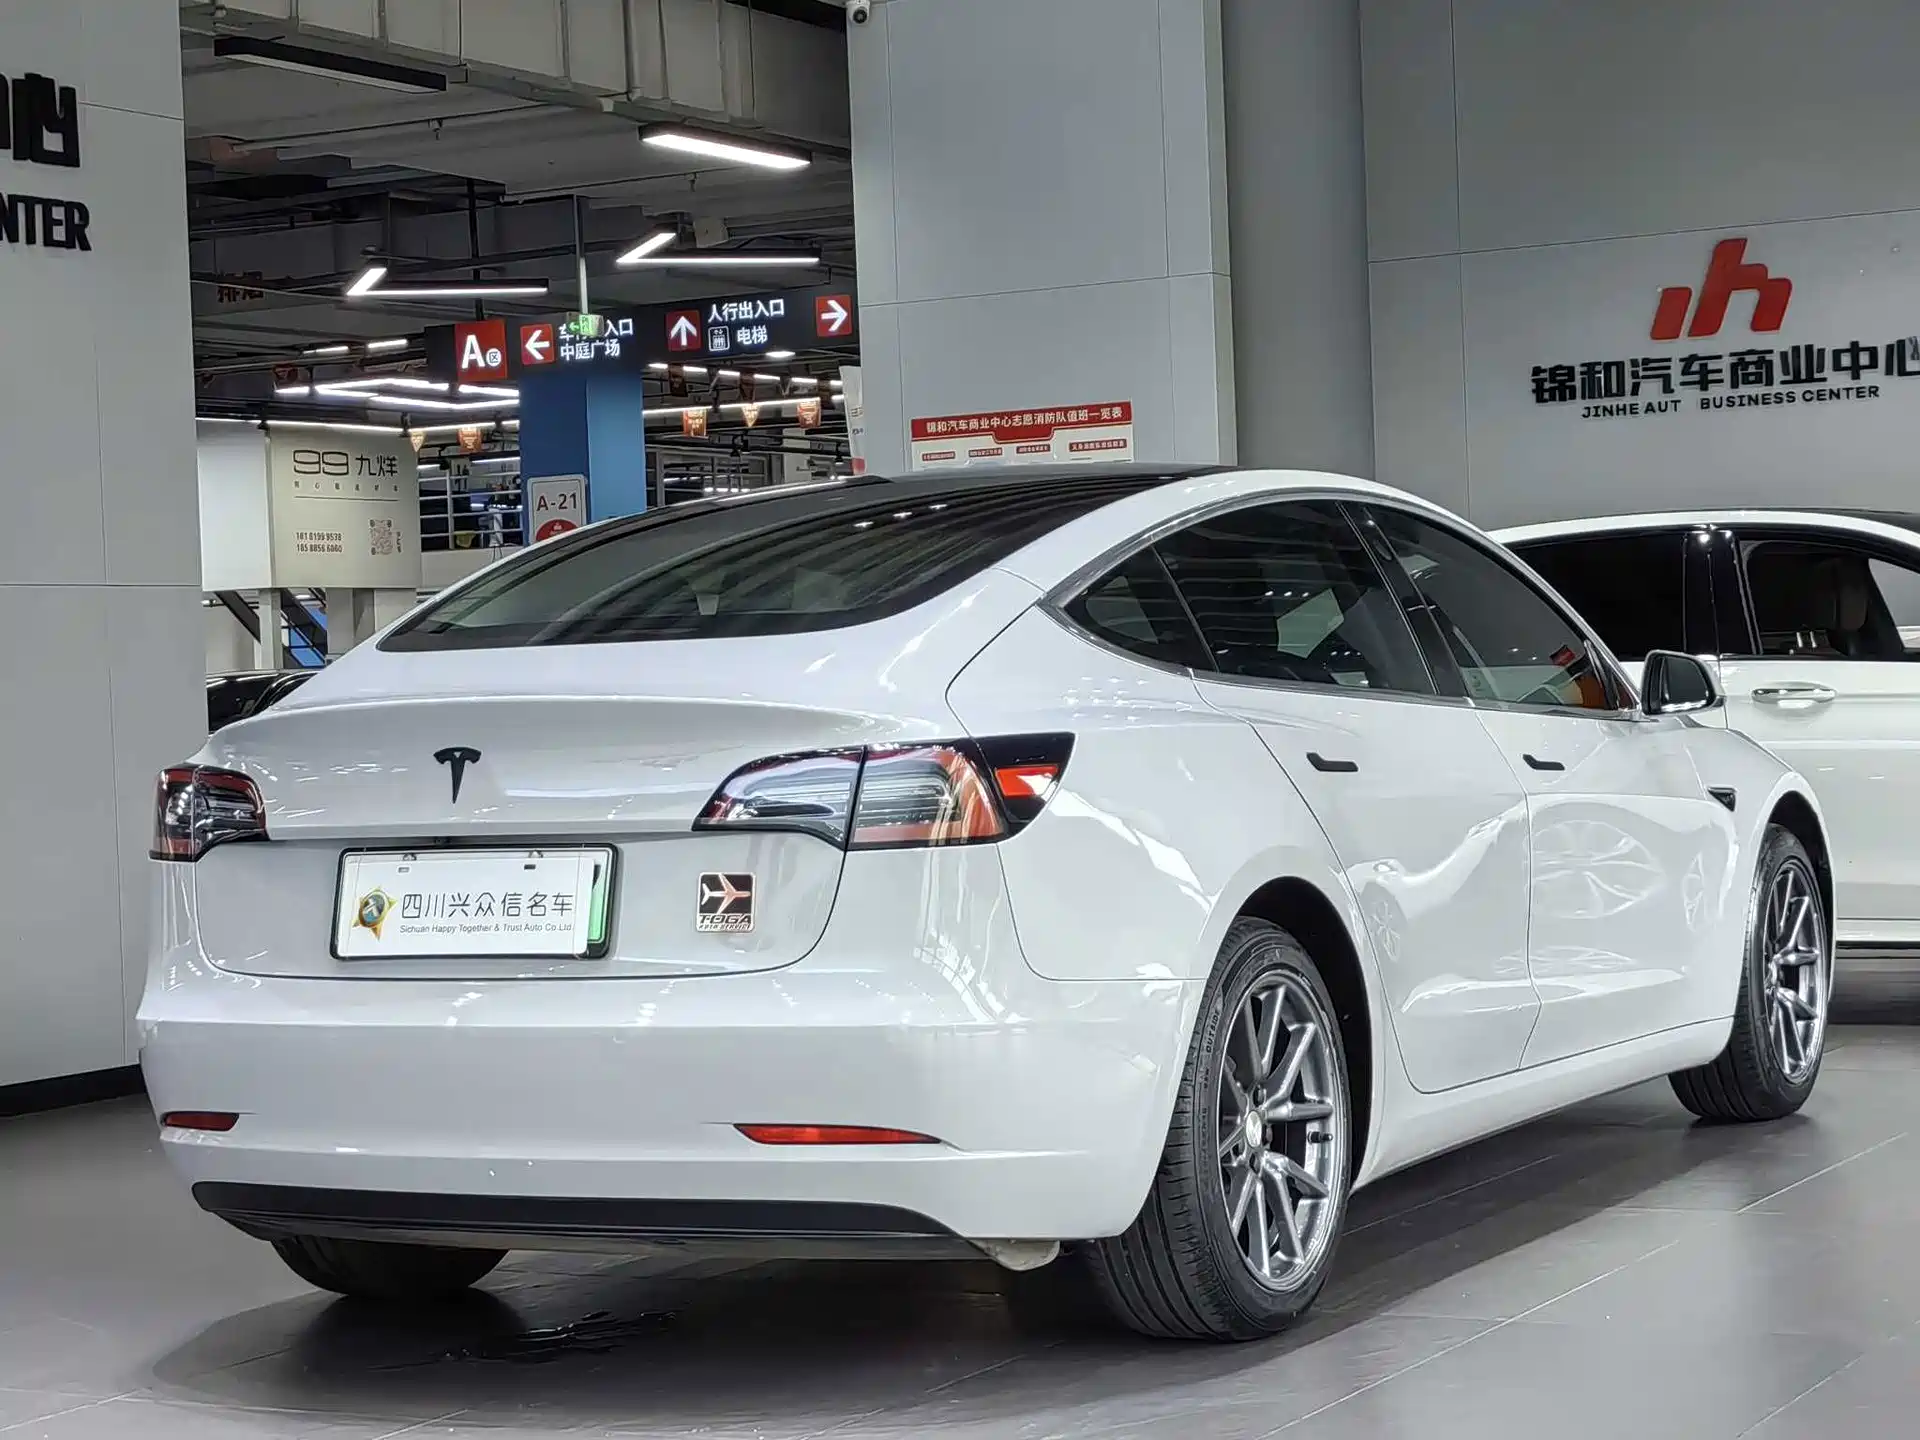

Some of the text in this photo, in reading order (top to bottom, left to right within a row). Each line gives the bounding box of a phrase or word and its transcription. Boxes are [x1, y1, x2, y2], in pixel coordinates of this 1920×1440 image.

[707, 299, 785, 323] 人行出入口
[736, 325, 768, 345] 电梯
[560, 338, 620, 361] 中庭广场
[1531, 338, 1920, 404] 锦和汽车商业中心
[1582, 385, 1880, 419] JINHE AUT BUSINESS CENTER
[293, 449, 350, 476] 99
[536, 492, 577, 511] A-21
[402, 891, 574, 919] 四川兴众信名车
[400, 924, 430, 934] Sichuan
[432, 923, 456, 934] Happy
[459, 922, 492, 934] Together
[494, 923, 500, 932] &
[504, 922, 523, 932] Trust
[524, 922, 543, 932] Auto
[699, 914, 751, 924] TOGA
